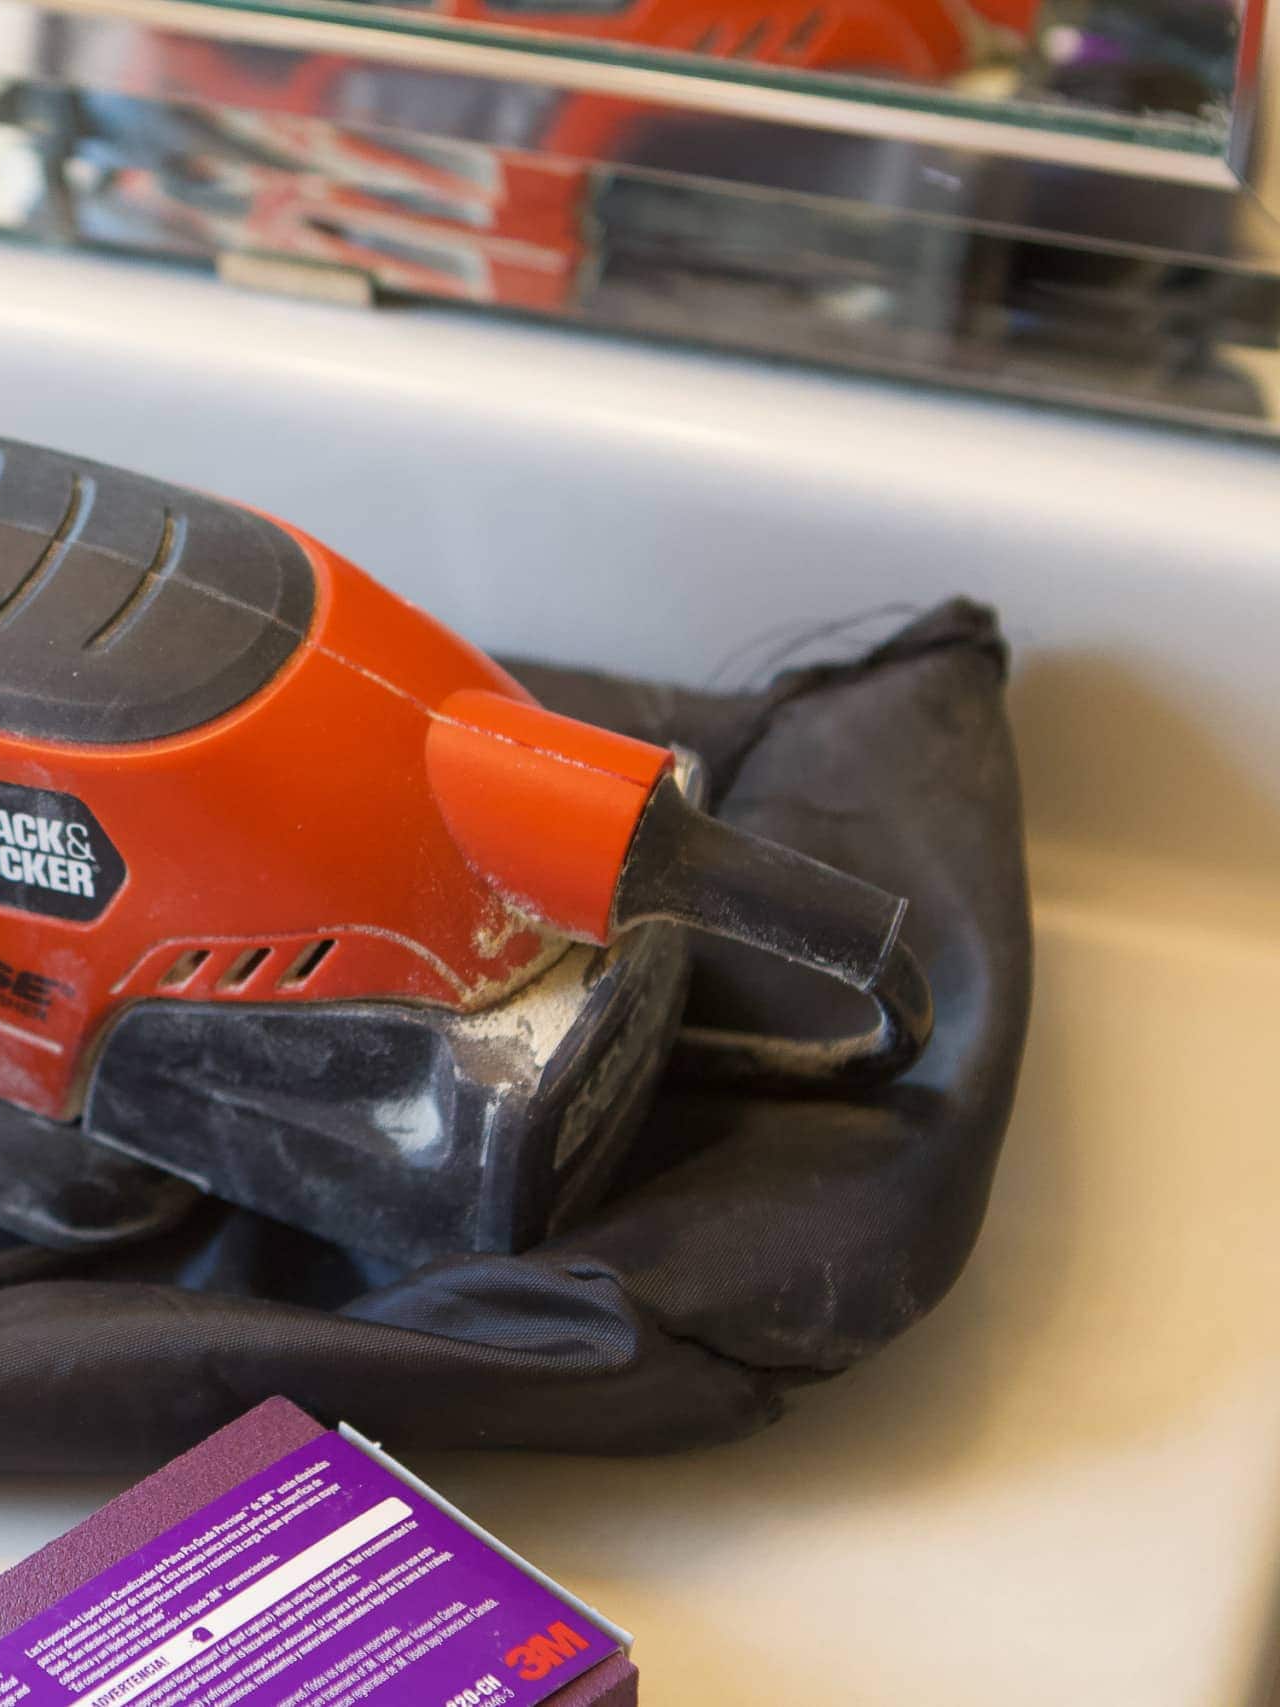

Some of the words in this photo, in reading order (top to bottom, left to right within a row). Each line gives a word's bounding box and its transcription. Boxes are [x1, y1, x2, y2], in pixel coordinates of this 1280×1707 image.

[24, 1645, 41, 1658] Las
[37, 1625, 72, 1649] Esponjas
[69, 1619, 81, 1629] de
[76, 1605, 102, 1623] Lijado
[154, 1563, 166, 1576] de
[161, 1551, 185, 1567] Polvo
[179, 1543, 197, 1555] Pro
[192, 1530, 217, 1550] Grade
[250, 1502, 266, 1511] de
[36, 1652, 56, 1668] para
[51, 1644, 66, 1656] las
[63, 1621, 101, 1649] demandas
[98, 1612, 112, 1625] del
[107, 1602, 129, 1618] lugar
[124, 1596, 139, 1606] de
[246, 1513, 267, 1529] polvo
[264, 1508, 276, 1517] de
[311, 1479, 323, 1487] de
[66, 1648, 85, 1662] Son
[81, 1632, 110, 1652] ideales
[107, 1621, 125, 1637] para
[136, 1588, 176, 1616] superficies
[173, 1569, 205, 1593] pintadas
[267, 1519, 283, 1530] que
[290, 1588, 314, 1605] using
[361, 1525, 409, 1558] recommended
[386, 1585, 398, 1595] de
[417, 1565, 429, 1574] de
[125, 1643, 141, 1656] con
[137, 1636, 152, 1647] las
[149, 1616, 182, 1640] esponjas
[179, 1610, 191, 1620] de
[294, 1586, 337, 1620] professional
[104, 1636, 128, 1653] lijado
[504, 1619, 590, 1681] 3M
